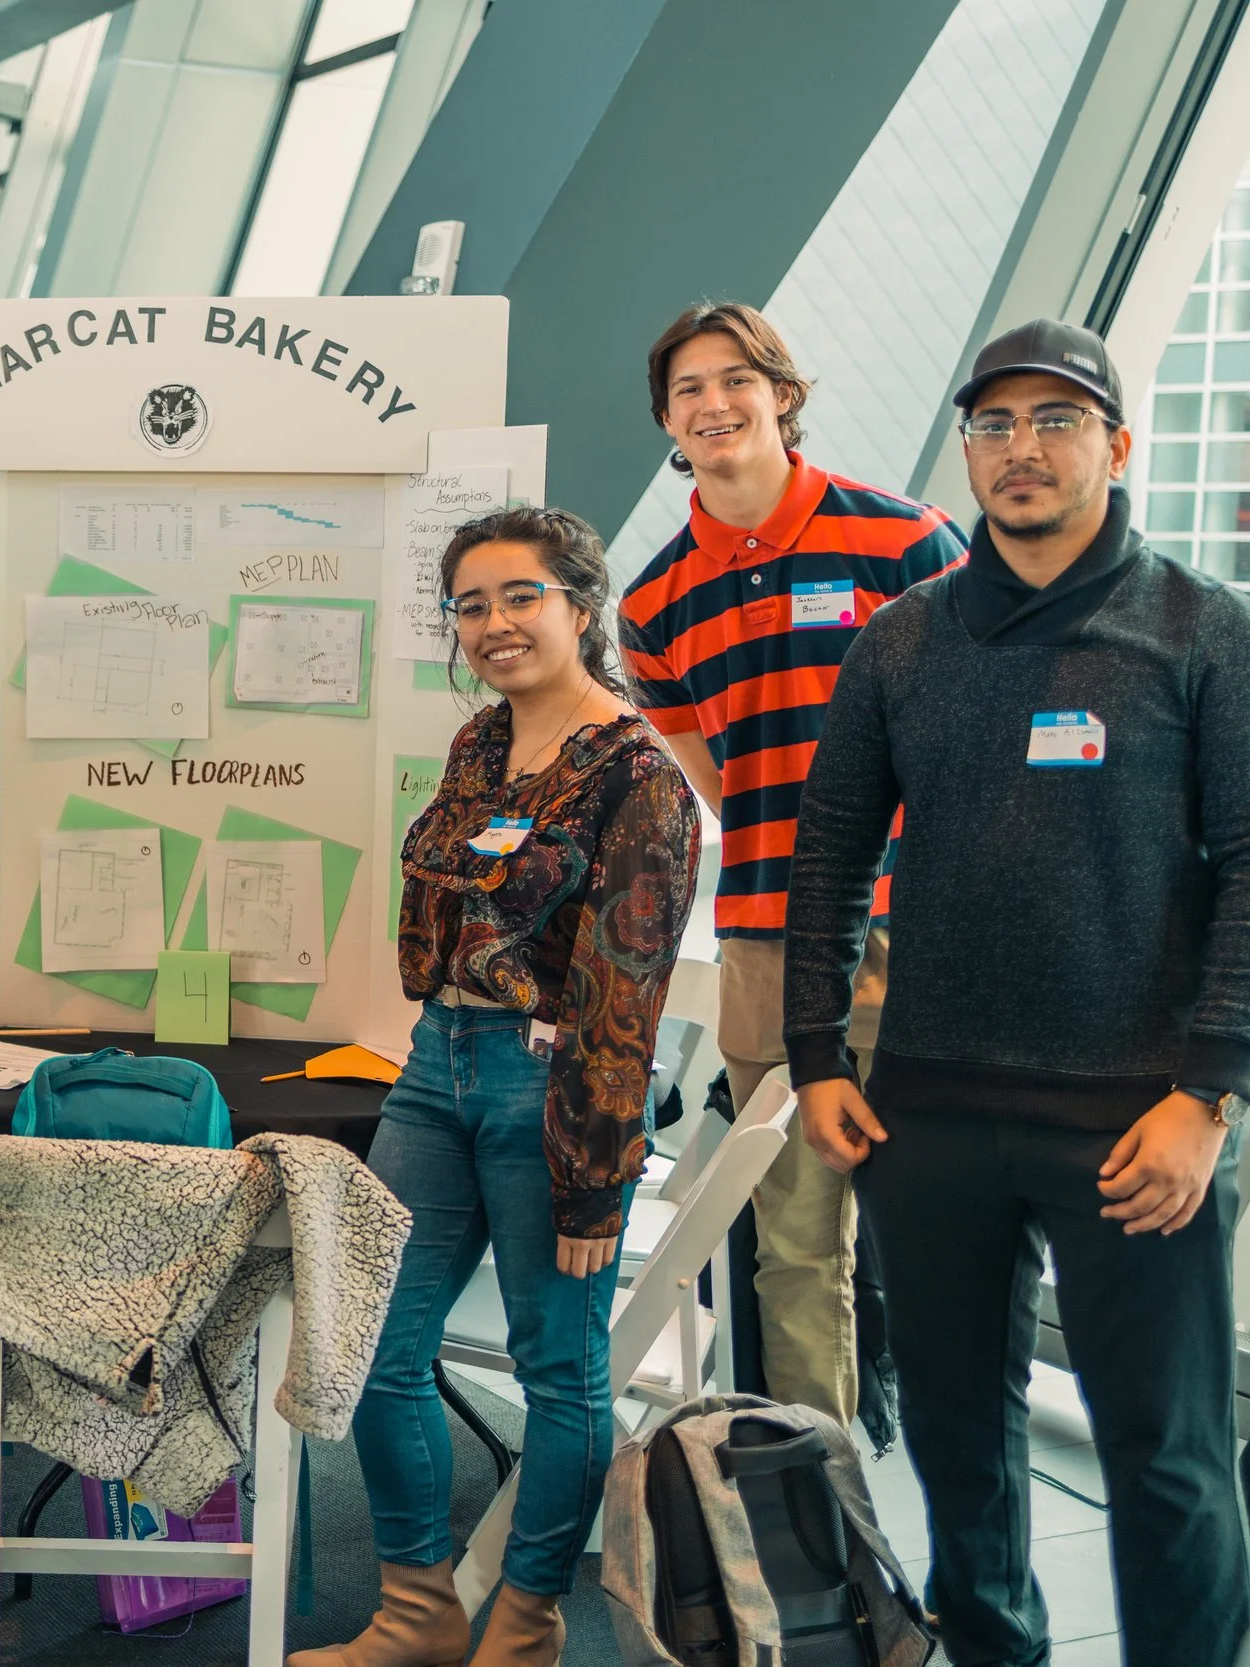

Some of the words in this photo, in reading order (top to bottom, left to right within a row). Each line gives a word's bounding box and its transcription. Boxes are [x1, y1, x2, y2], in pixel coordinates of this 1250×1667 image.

[204, 306, 416, 423] BAKERY
[408, 473, 463, 489] Structural
[435, 490, 492, 508] Assumptions
[239, 555, 283, 588] MEP
[287, 554, 339, 583] PLAN
[83, 601, 143, 619] Existing
[142, 602, 180, 620] Floor
[166, 610, 209, 632] Plan
[1056, 713, 1079, 722] Hello
[87, 760, 153, 787] NEW
[170, 759, 306, 788] FLOORPLANS
[400, 772, 440, 800] Lightin
[182, 970, 209, 1023] 4
[108, 1483, 123, 1541] Expanding
